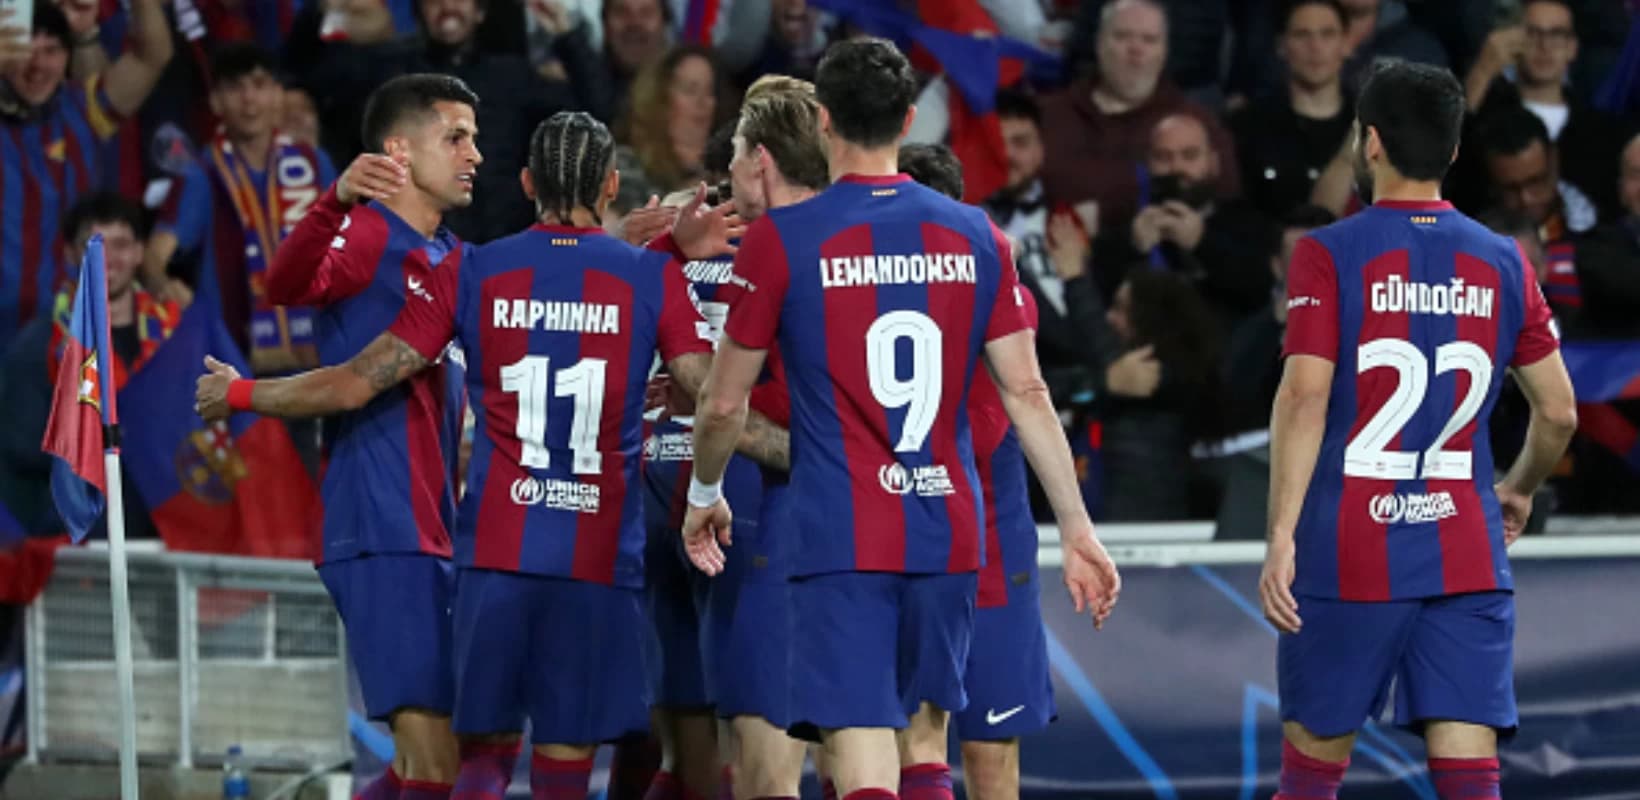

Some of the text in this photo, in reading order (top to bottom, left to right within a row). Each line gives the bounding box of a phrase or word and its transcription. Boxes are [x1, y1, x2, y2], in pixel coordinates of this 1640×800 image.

[682, 260, 734, 284] OUND
[820, 254, 976, 287] LEWANDOWSKI
[493, 298, 619, 334] RAPHINHA
[1371, 274, 1494, 318] GÜNDOĞAN
[866, 310, 943, 453] 9
[500, 355, 608, 475] 11
[1343, 337, 1494, 480] 22
